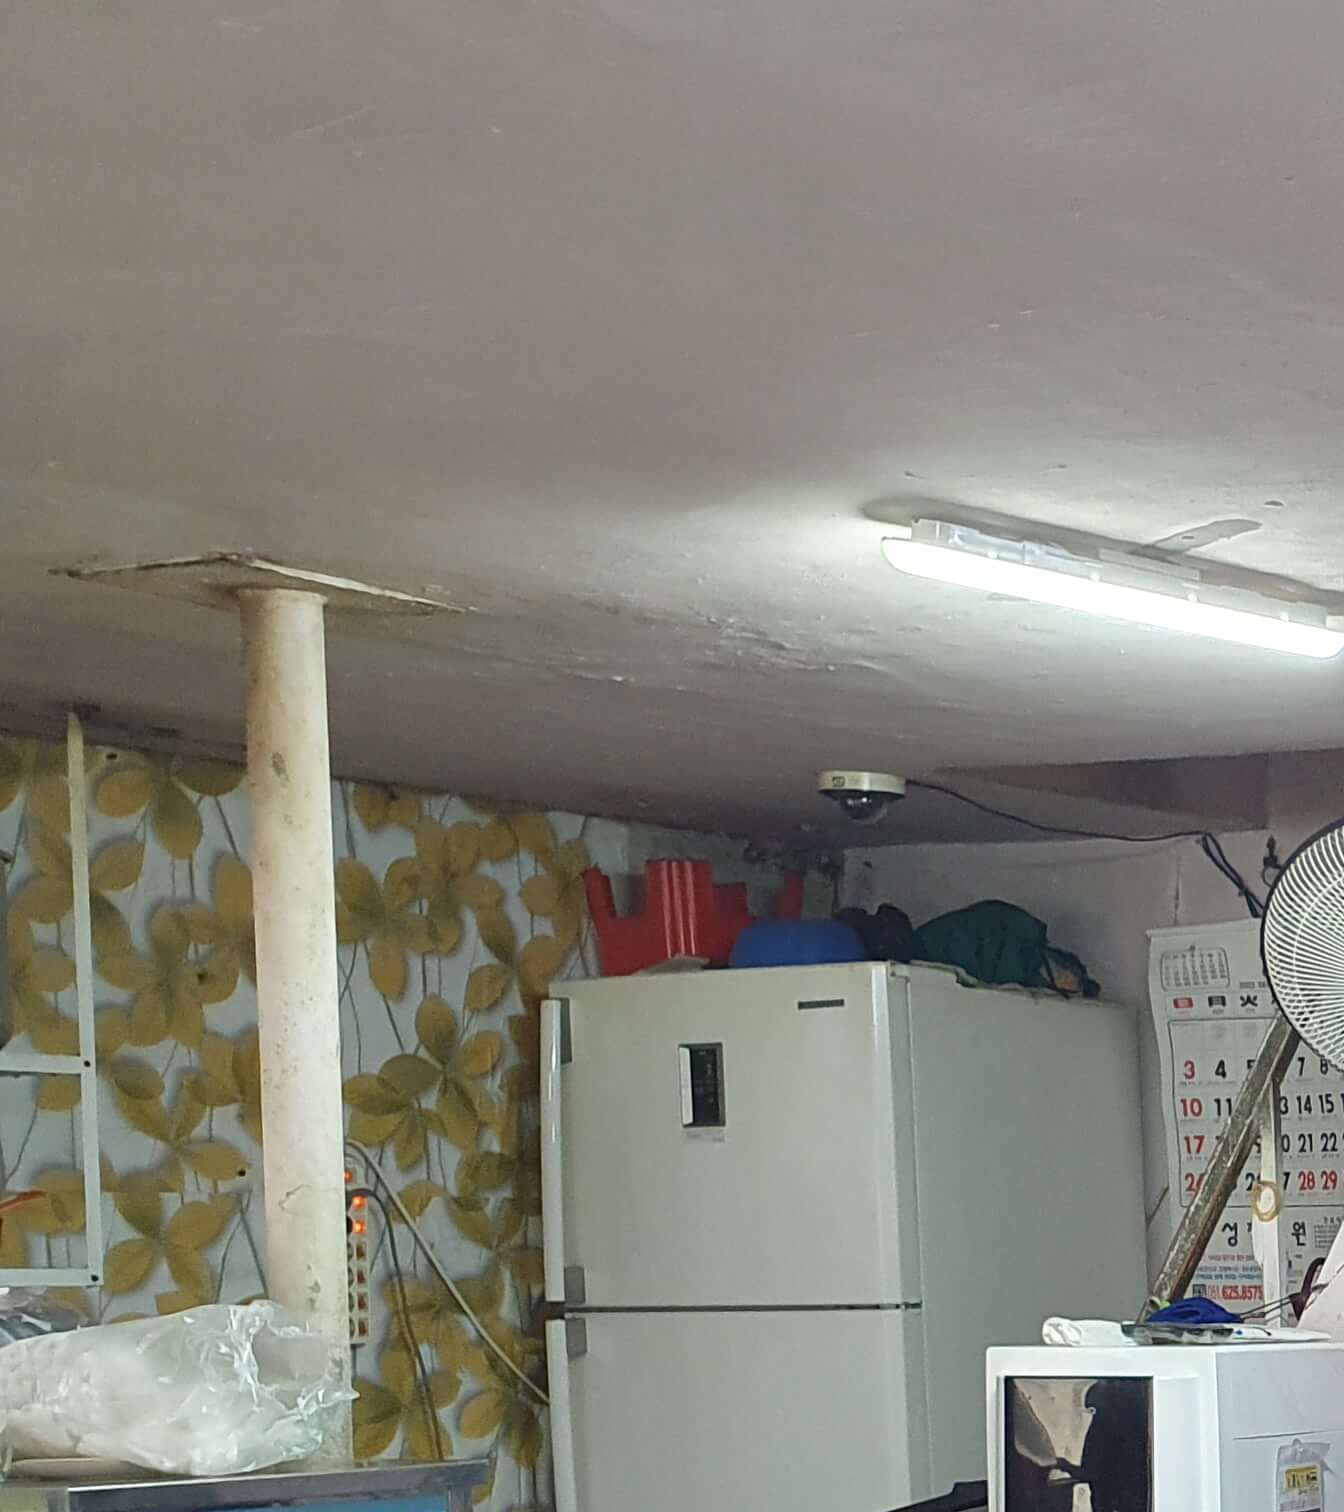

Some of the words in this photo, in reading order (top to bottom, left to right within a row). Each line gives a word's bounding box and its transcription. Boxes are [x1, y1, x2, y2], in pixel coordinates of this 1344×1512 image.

[1184, 1060, 1195, 1079] 3
[1214, 1059, 1227, 1078] 4
[1297, 1057, 1305, 1076] 7
[1319, 1056, 1329, 1075] 8
[1180, 1098, 1203, 1117] 10
[1214, 1097, 1232, 1117] 11
[1280, 1096, 1289, 1115] 3
[1296, 1095, 1313, 1114] 14
[1318, 1094, 1335, 1113] 15
[1184, 1135, 1205, 1154] 17
[1297, 1133, 1314, 1153] 21
[1320, 1132, 1338, 1152] 22
[1297, 1171, 1316, 1190] 28
[1320, 1170, 1337, 1190] 29
